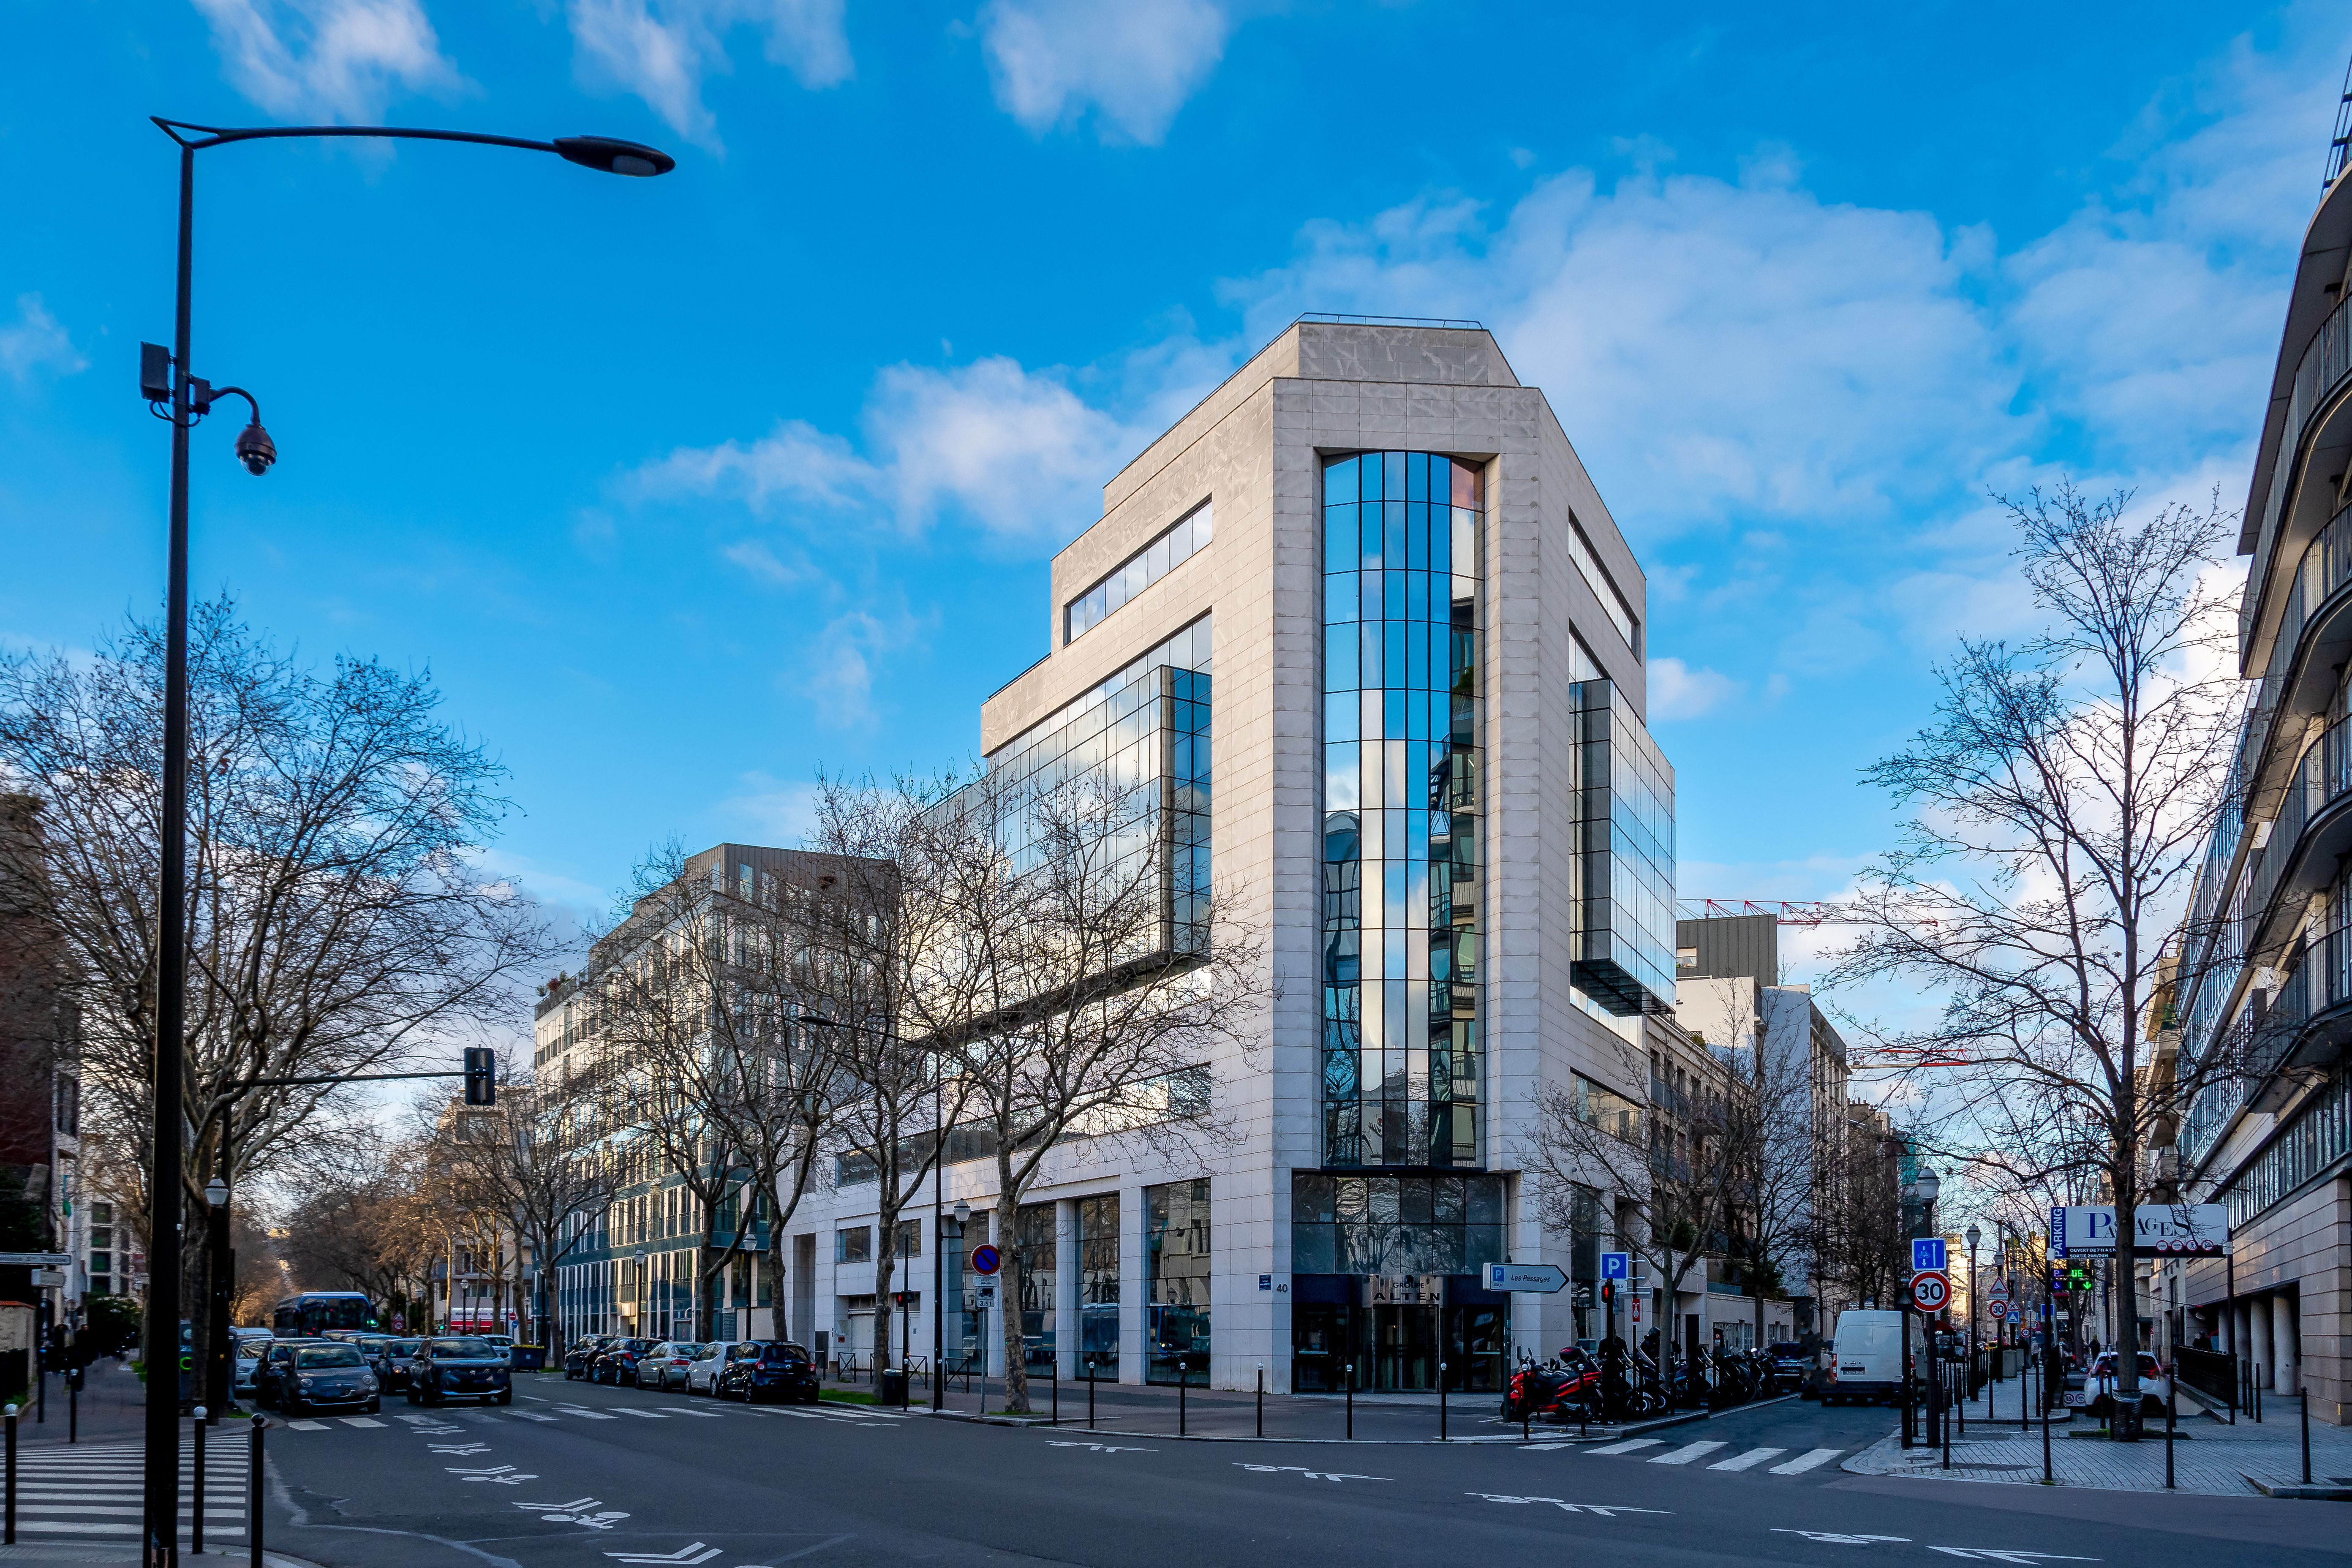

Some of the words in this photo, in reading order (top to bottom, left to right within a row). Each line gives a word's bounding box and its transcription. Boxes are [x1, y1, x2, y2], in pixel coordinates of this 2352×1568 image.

[2053, 1209, 2063, 1257] PARKING
[1609, 1258, 1620, 1274] P
[1496, 1270, 1501, 1279] P
[1522, 1274, 1550, 1284] Passages
[1276, 1284, 1288, 1293] 40
[1918, 1283, 1943, 1300] 30
[1374, 1293, 1440, 1301] ALTEN
